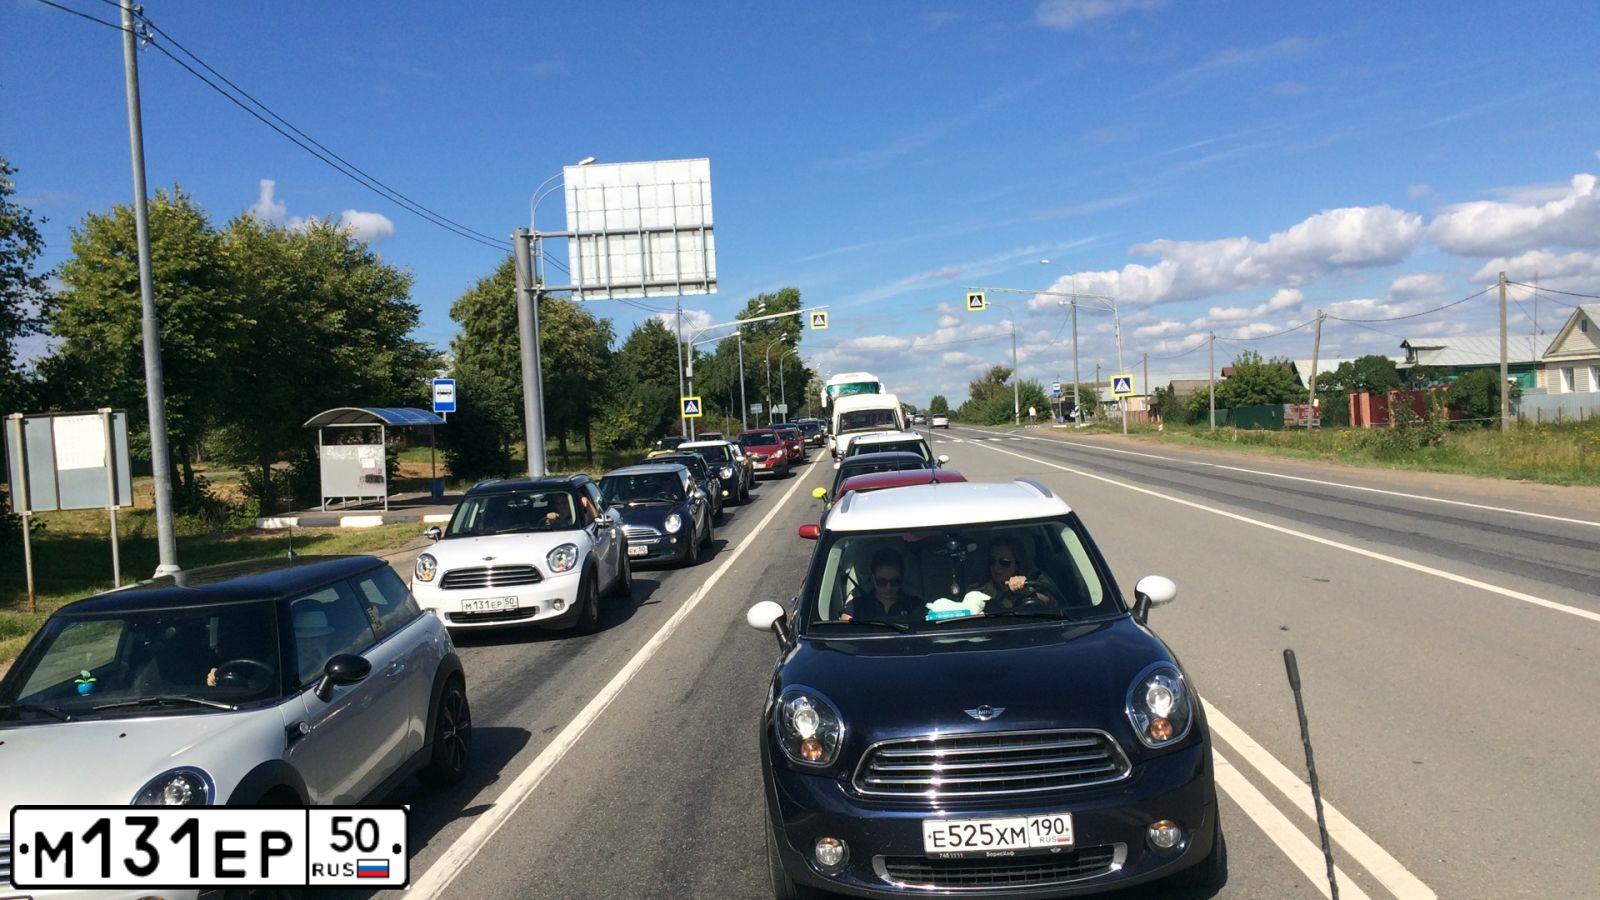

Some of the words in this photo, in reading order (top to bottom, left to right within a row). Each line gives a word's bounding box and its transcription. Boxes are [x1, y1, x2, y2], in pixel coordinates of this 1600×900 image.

[465, 600, 502, 610] М131ЕР
[933, 823, 1026, 848] Е525ХМ
[1030, 817, 1064, 836] 190
